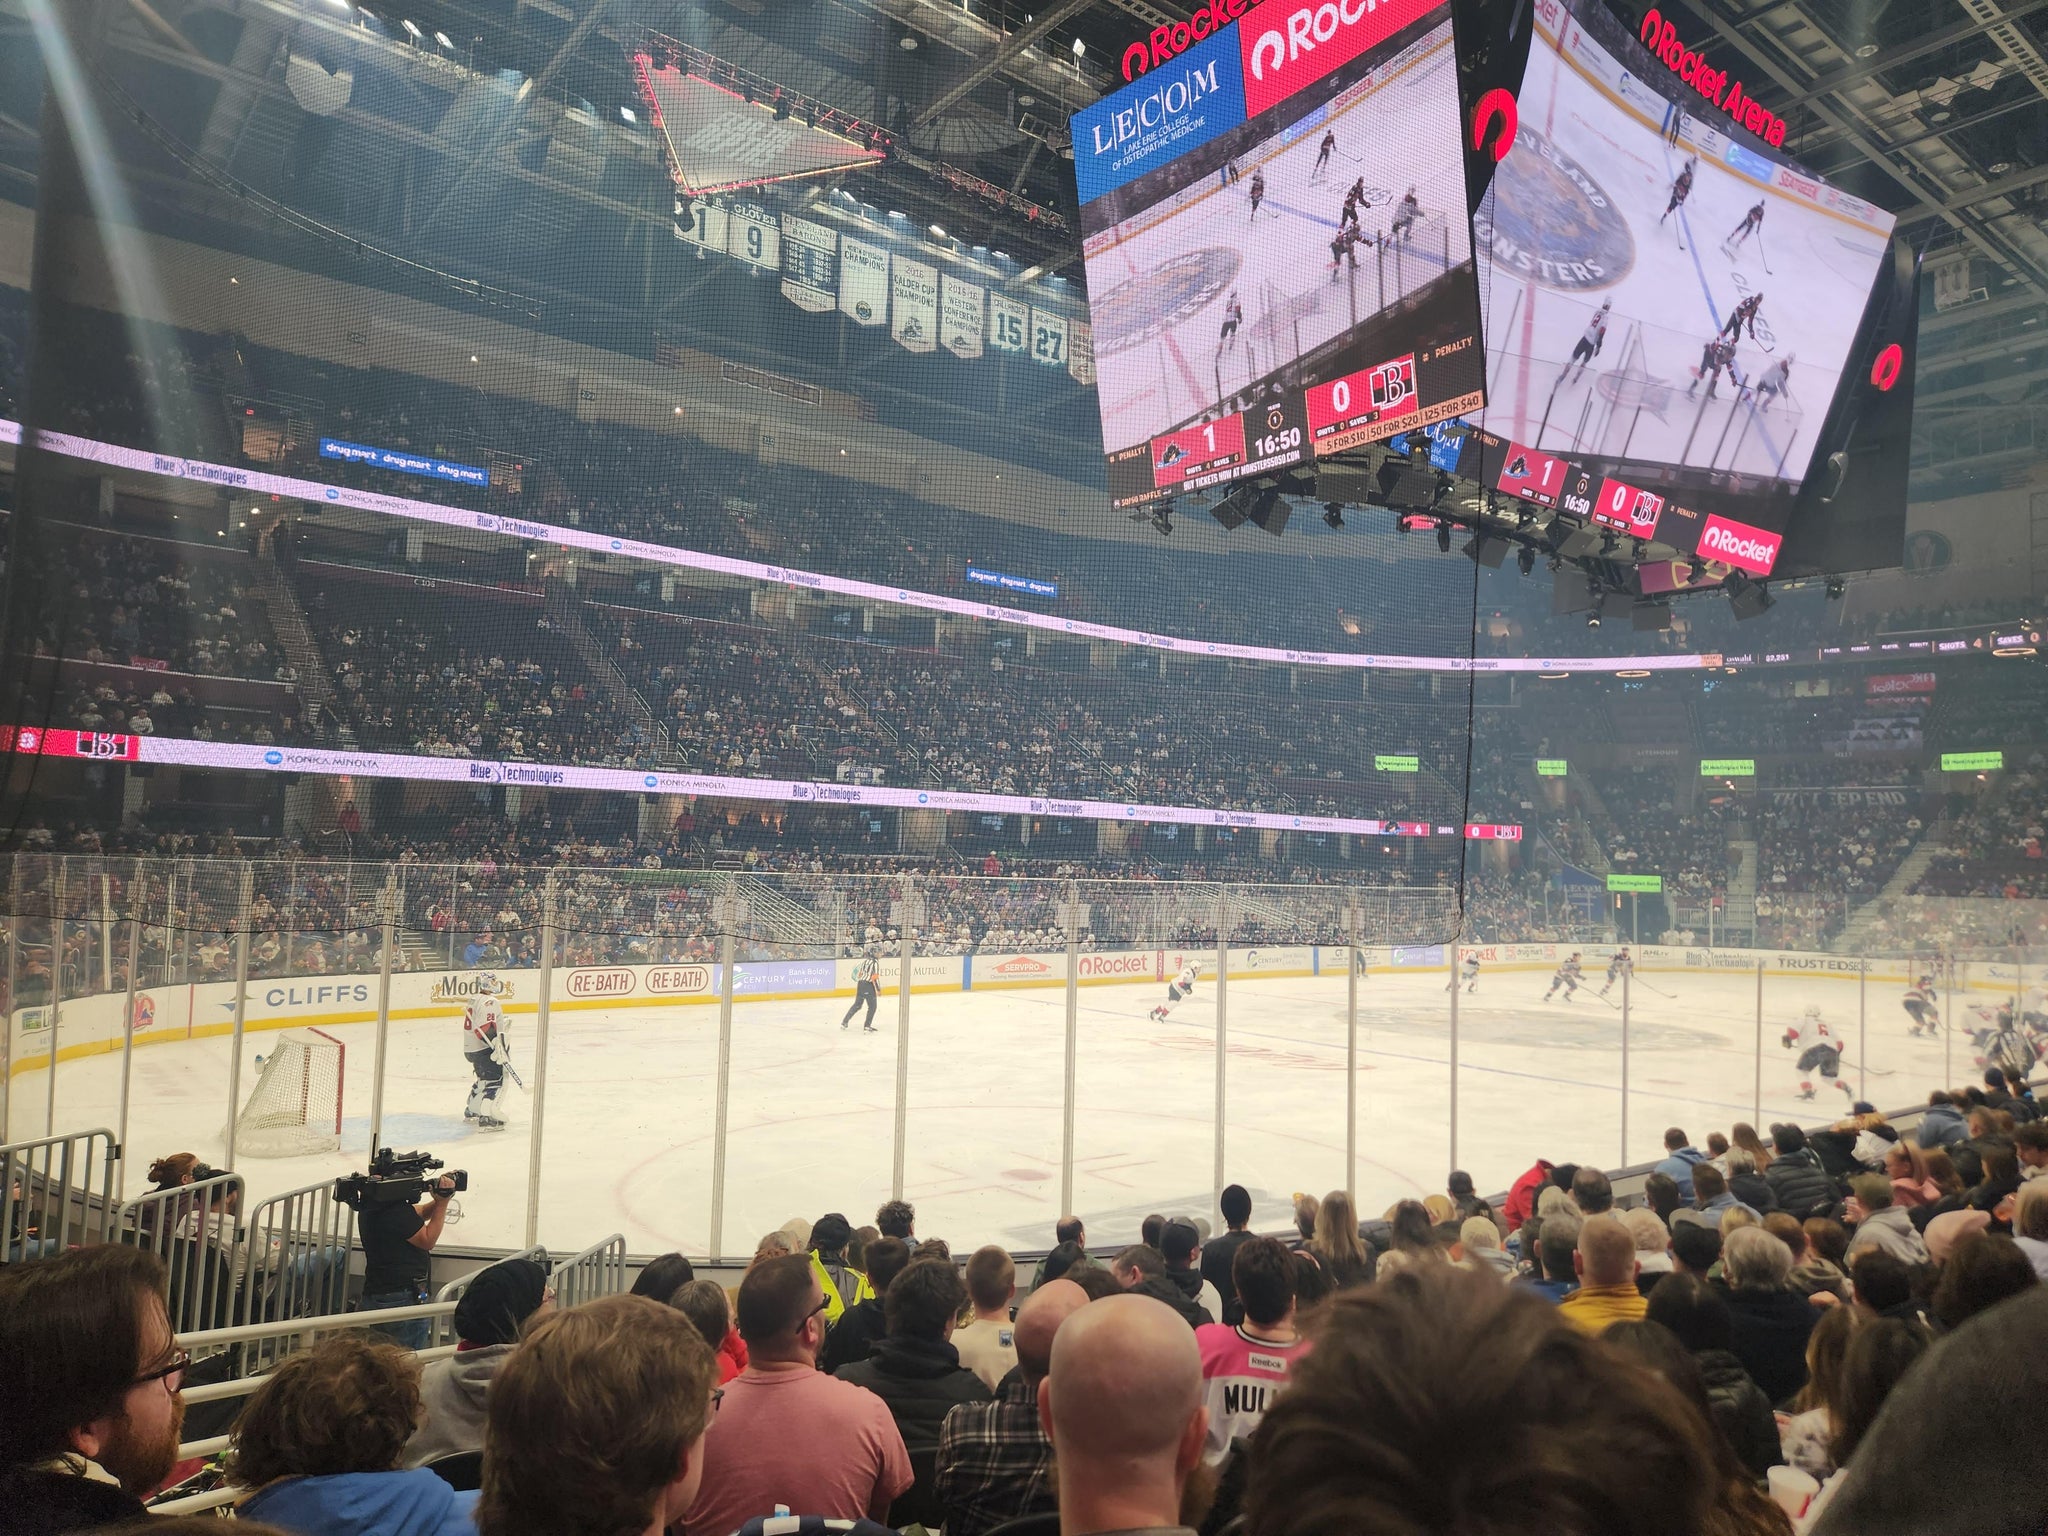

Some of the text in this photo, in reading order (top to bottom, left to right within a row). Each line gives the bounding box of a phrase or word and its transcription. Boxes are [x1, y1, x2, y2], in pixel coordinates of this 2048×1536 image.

[1656, 20, 1727, 107] Rocket
[1721, 81, 1786, 148] Arena
[1112, 115, 1206, 172] OF OSTEOPATHIC MEDICINE
[1124, 113, 1190, 155] LAKE ERIE COLLEGE
[734, 204, 776, 226] GLOVER
[784, 216, 835, 240] CLEVELAND
[793, 228, 826, 245] BARONS
[748, 226, 762, 258] 9
[844, 250, 886, 272] CHAMPIONS
[906, 265, 924, 278] 2016
[894, 274, 935, 295] CALDER CUP
[894, 286, 934, 307] CHAMPIONS
[949, 296, 977, 312] WESTERN
[944, 305, 982, 326] CONFERENCE
[946, 316, 980, 335] CHAMPIONS
[997, 312, 1022, 346] 15
[1036, 326, 1062, 360] 27
[1435, 336, 1472, 358] PENALTY
[1332, 380, 1350, 413] 0
[1334, 396, 1480, 448] FOR $10 50 FOR $20 125 FOR $40
[1203, 424, 1216, 452] 1
[1255, 427, 1300, 457] 16:50
[154, 456, 248, 486] Blue Technologies
[326, 442, 483, 481] drug mart drug mart drug mart
[1184, 480, 1194, 491] BUY
[1195, 472, 1218, 488] TICKETS
[1218, 470, 1232, 482] NOW
[1233, 466, 1240, 478] AT
[1542, 460, 1554, 486] 1
[342, 492, 409, 510] KONICA MINOLTA
[1140, 490, 1162, 500] RAFFLE
[1564, 494, 1590, 514] 16:50
[1612, 486, 1626, 512] 0
[1676, 506, 1698, 520] PENALTY
[476, 514, 550, 538] Blue Technologies
[623, 542, 677, 558] KONICA MINOLTA
[1720, 530, 1774, 564] Rocket
[767, 566, 821, 586] Blue Technologies
[1000, 608, 1029, 623] Technologies
[1938, 641, 1967, 650] SHOTS
[1973, 638, 1982, 648] 4
[1996, 635, 2024, 645] SAVES
[1466, 660, 1498, 670] Technologies
[287, 754, 378, 769] KONICA MINOLTA
[470, 764, 564, 784] Blue Technologies
[660, 779, 726, 790] KONICA MINOLTA
[792, 784, 861, 802] Blue Technologies
[1867, 790, 1906, 805] END
[1030, 800, 1082, 816] Blue Technologies
[1214, 812, 1256, 826] Blue Technologies
[1414, 826, 1422, 836] 4
[1438, 826, 1454, 834] SHOTS
[1472, 827, 1480, 836] 0
[789, 968, 831, 976] Bank Boldly.
[913, 966, 946, 976] MUTUAL
[1005, 963, 1040, 972] SERVPRO
[1094, 954, 1148, 974] Rocket
[744, 976, 785, 984] CENTURY
[803, 977, 823, 985] Fully.
[266, 984, 368, 1007] CLIFFS
[1251, 1357, 1282, 1368] Reebok
